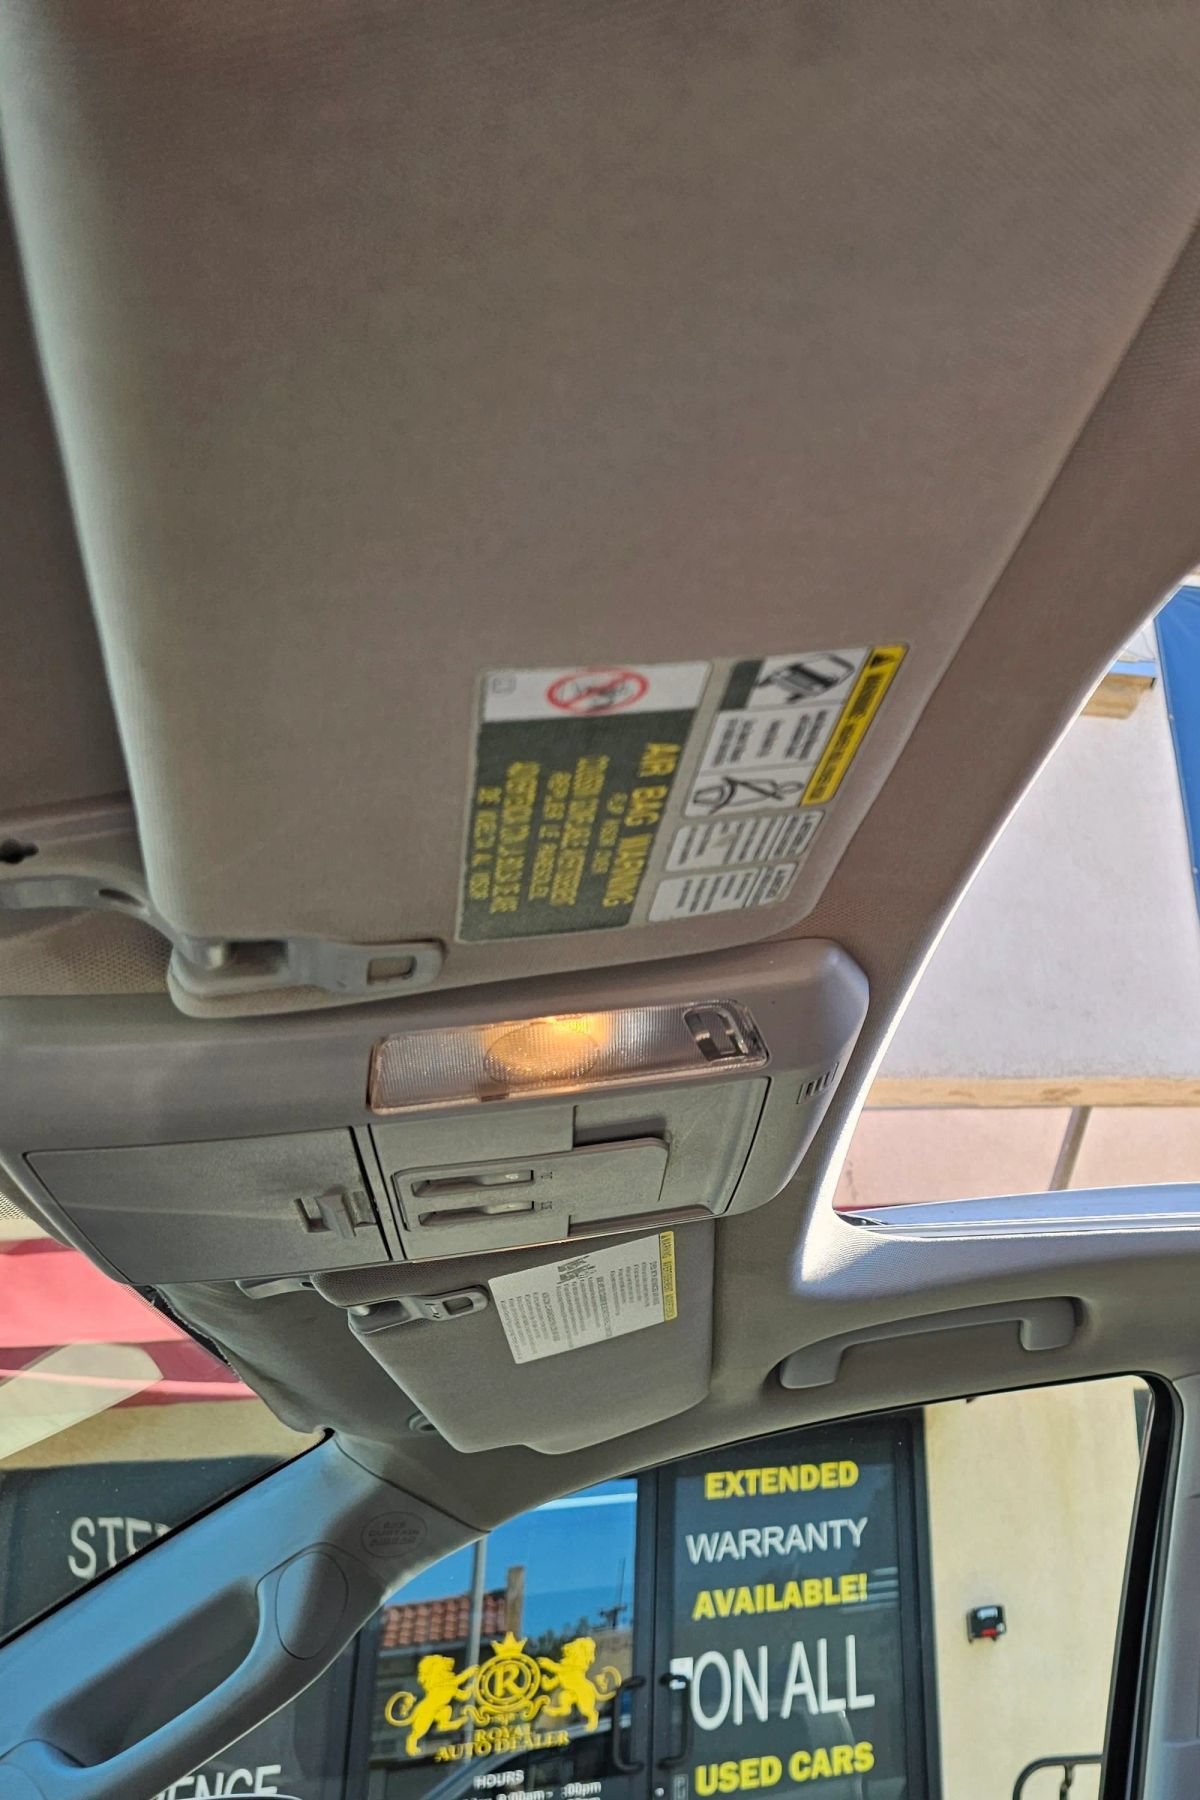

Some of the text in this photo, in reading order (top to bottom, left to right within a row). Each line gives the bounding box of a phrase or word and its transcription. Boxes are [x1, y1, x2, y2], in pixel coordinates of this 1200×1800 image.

[638, 742, 681, 778] AIR
[624, 785, 669, 827] BAG
[704, 1460, 859, 1500] EXTENDED
[685, 1517, 868, 1565] WARRANTY
[692, 1573, 868, 1621] AVAILABLE!
[494, 1664, 524, 1697] R
[690, 1634, 875, 1730] ON ALL
[435, 1730, 570, 1762] AUTO DEALER
[473, 1769, 525, 1790] HOURS
[694, 1741, 875, 1796] USED CARS
